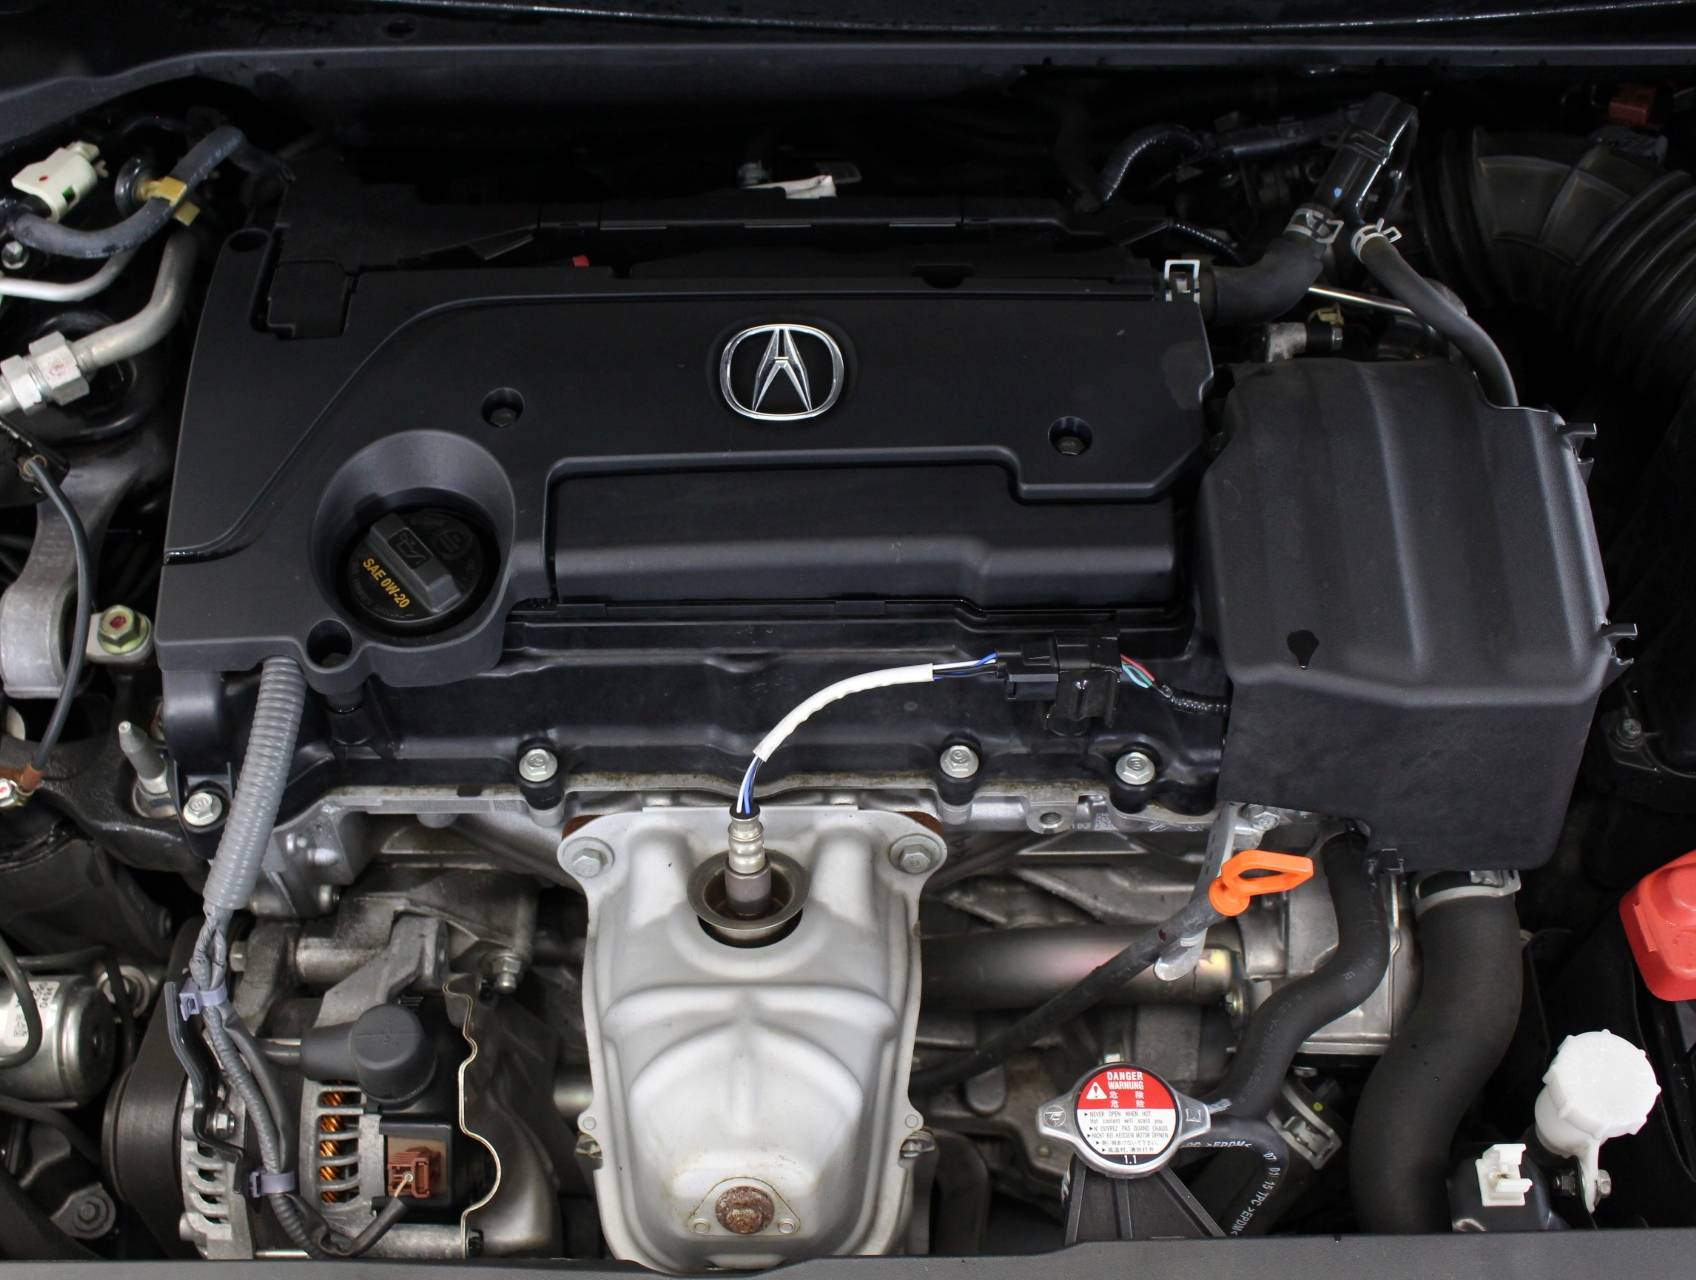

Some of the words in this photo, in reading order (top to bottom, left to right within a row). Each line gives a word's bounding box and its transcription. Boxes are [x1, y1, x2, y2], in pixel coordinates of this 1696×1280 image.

[362, 558, 387, 581] SAE
[380, 577, 411, 609] 0W-20
[1106, 1071, 1144, 1081] DANGER
[1107, 1081, 1145, 1090] WARNUNG
[1124, 1154, 1137, 1165] 1.1
[1251, 1190, 1270, 1207] TPC
